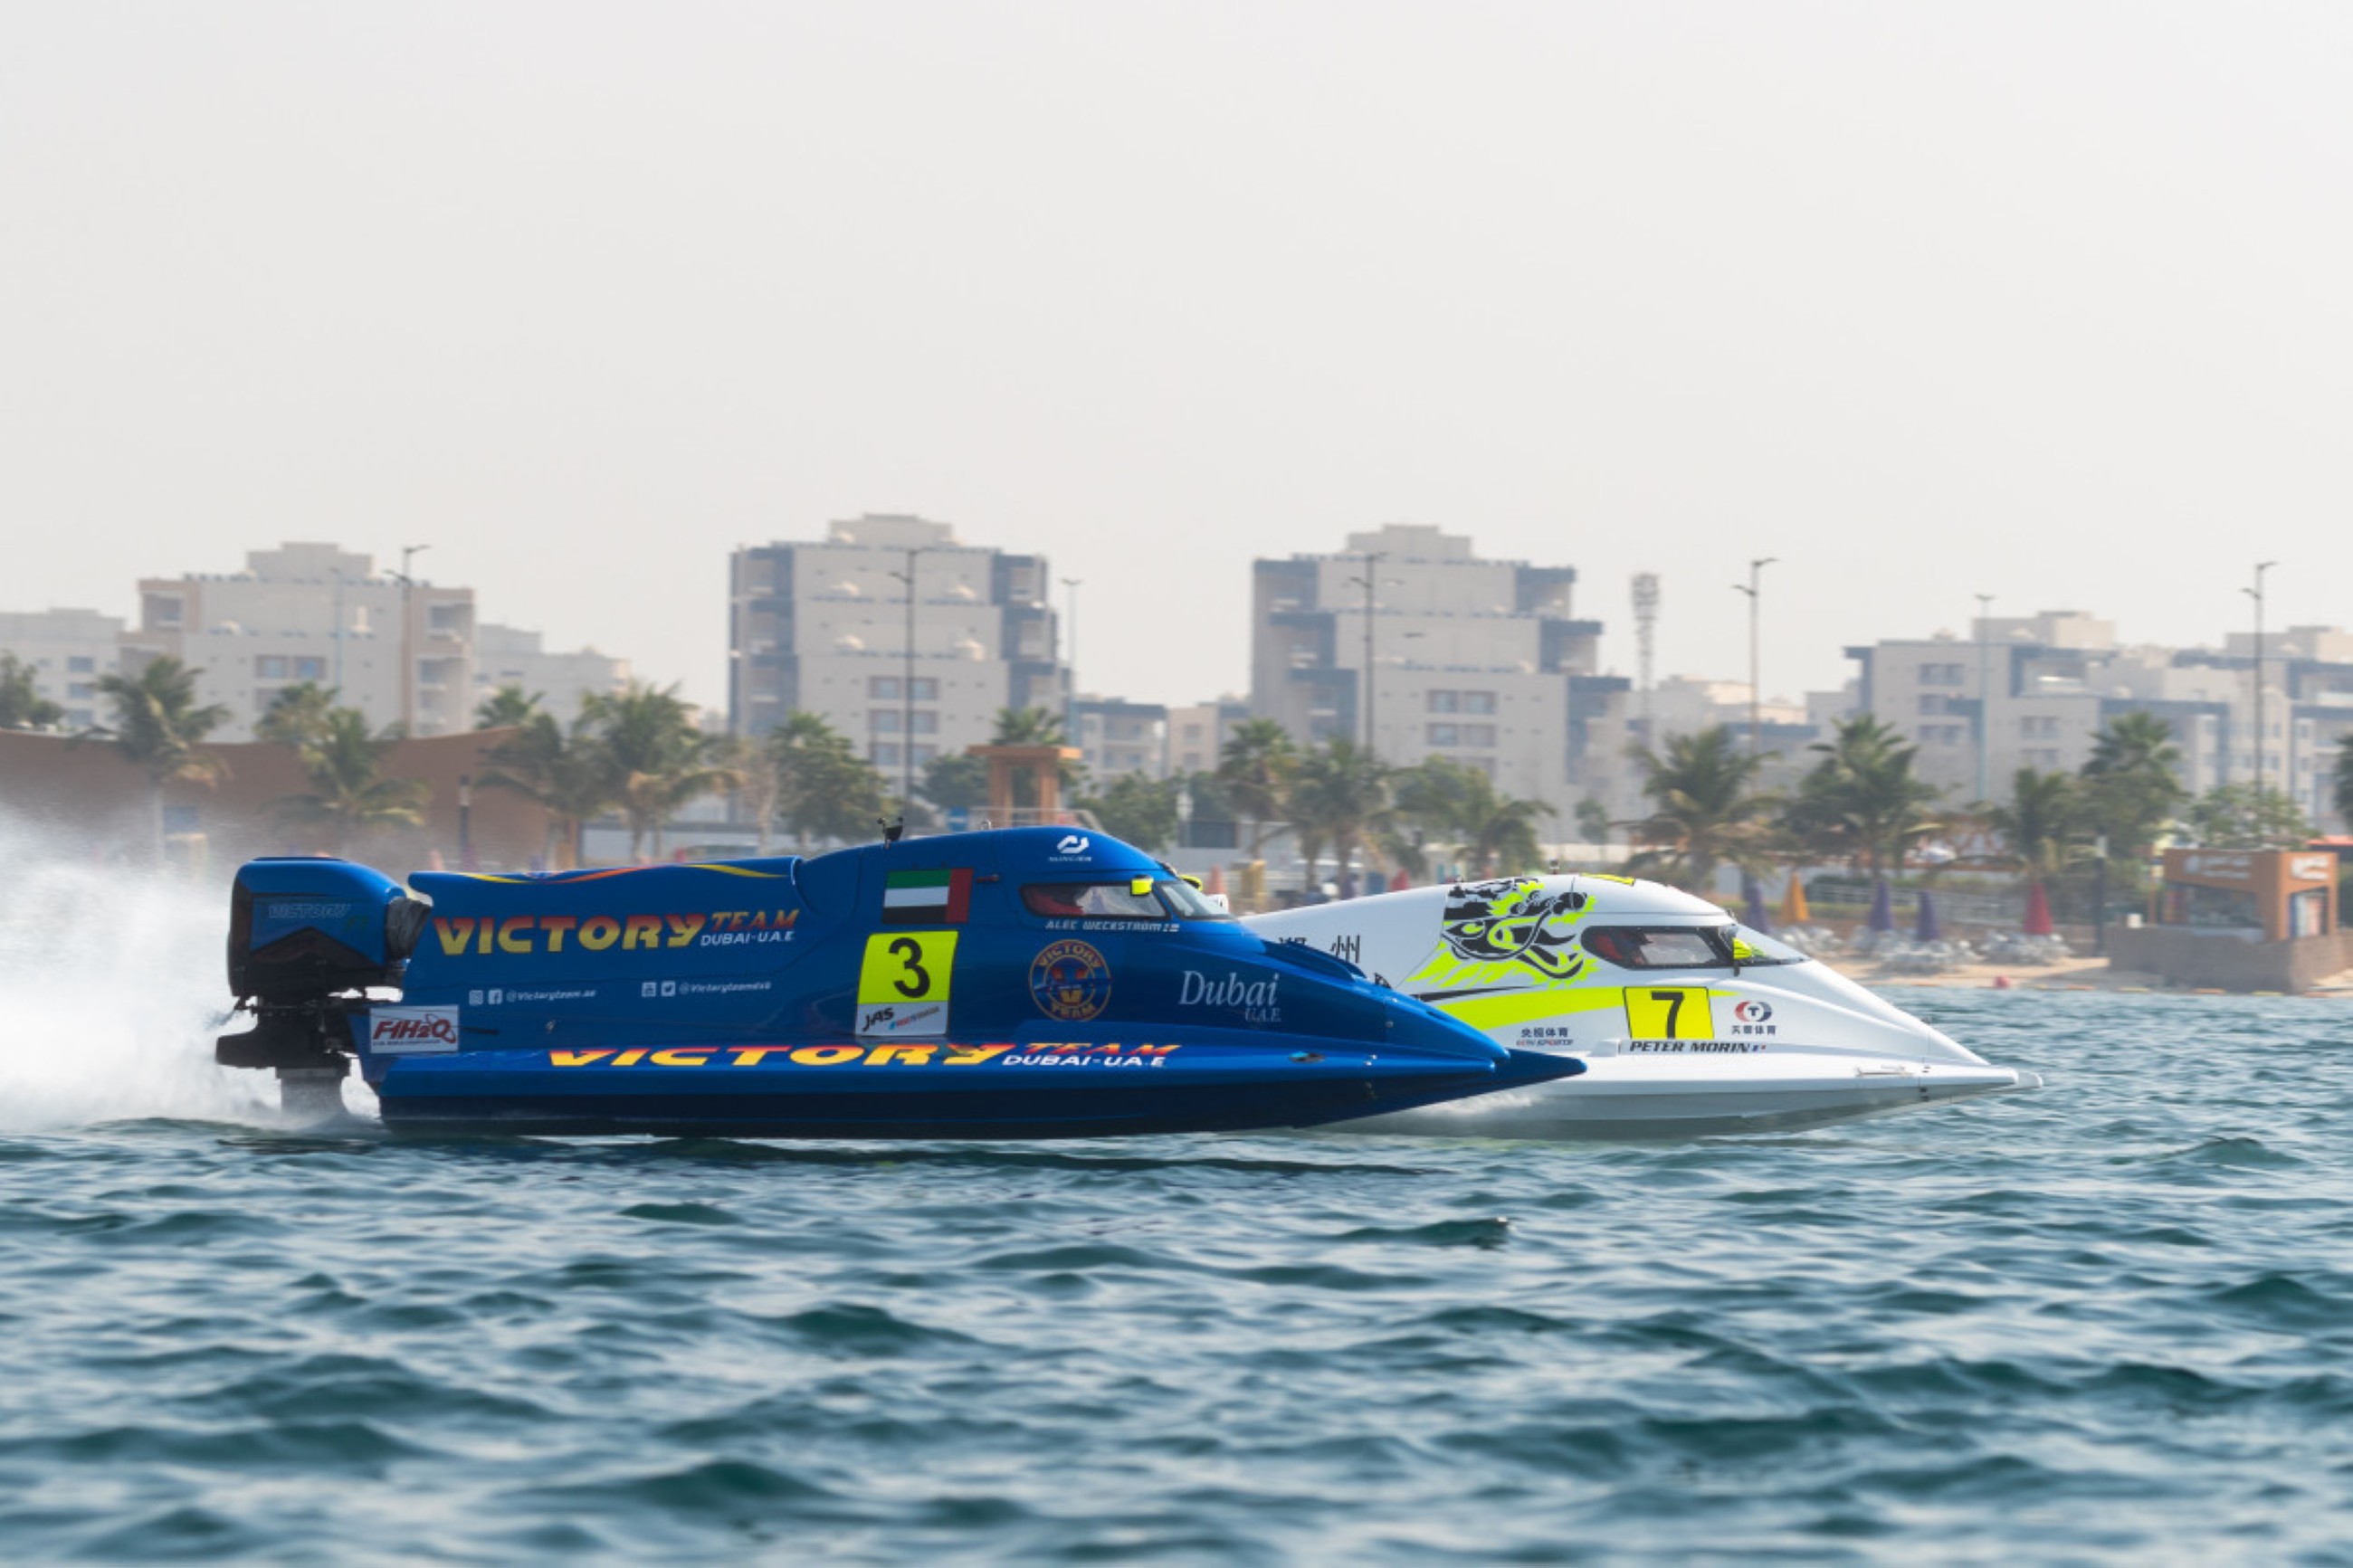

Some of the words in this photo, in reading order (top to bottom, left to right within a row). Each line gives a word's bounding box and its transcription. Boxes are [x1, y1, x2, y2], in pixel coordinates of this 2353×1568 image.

[433, 914, 707, 955] VICTORY
[711, 908, 800, 932] TEAM
[1044, 919, 1078, 930] ALEC
[888, 936, 930, 999] 3
[1035, 941, 1102, 968] VICTORY
[1177, 970, 1281, 1007] Dubai
[862, 1007, 895, 1032] JAS
[1651, 991, 1685, 1040] 7
[548, 1043, 1017, 1067] VICTORY
[1023, 1042, 1182, 1056] TEAM
[1629, 1041, 1686, 1052] PETER
[1690, 1041, 1750, 1053] MORIN
